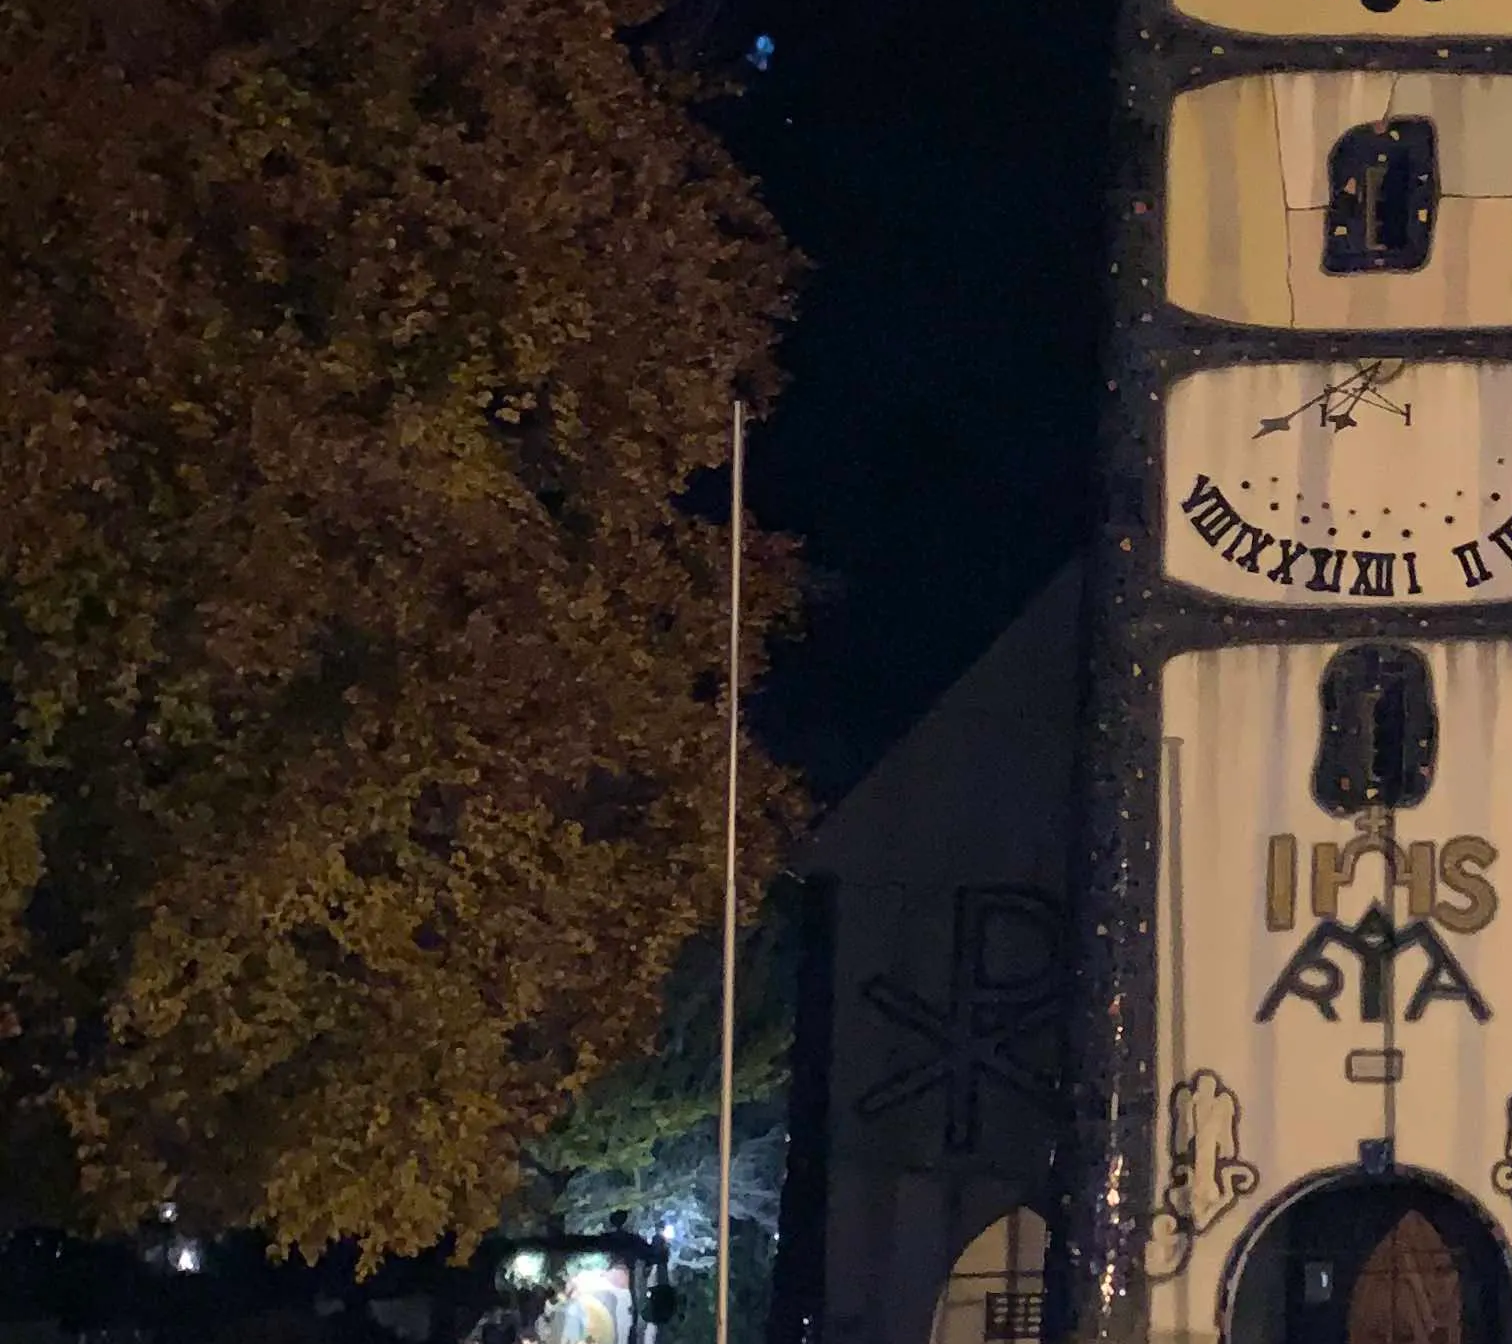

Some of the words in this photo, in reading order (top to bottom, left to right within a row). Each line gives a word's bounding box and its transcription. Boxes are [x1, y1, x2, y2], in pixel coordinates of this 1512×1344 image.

[1221, 522, 1275, 573] IX
[1267, 539, 1308, 584] X
[1349, 551, 1396, 596] XII
[1403, 552, 1422, 594] I
[1452, 540, 1493, 587] II
